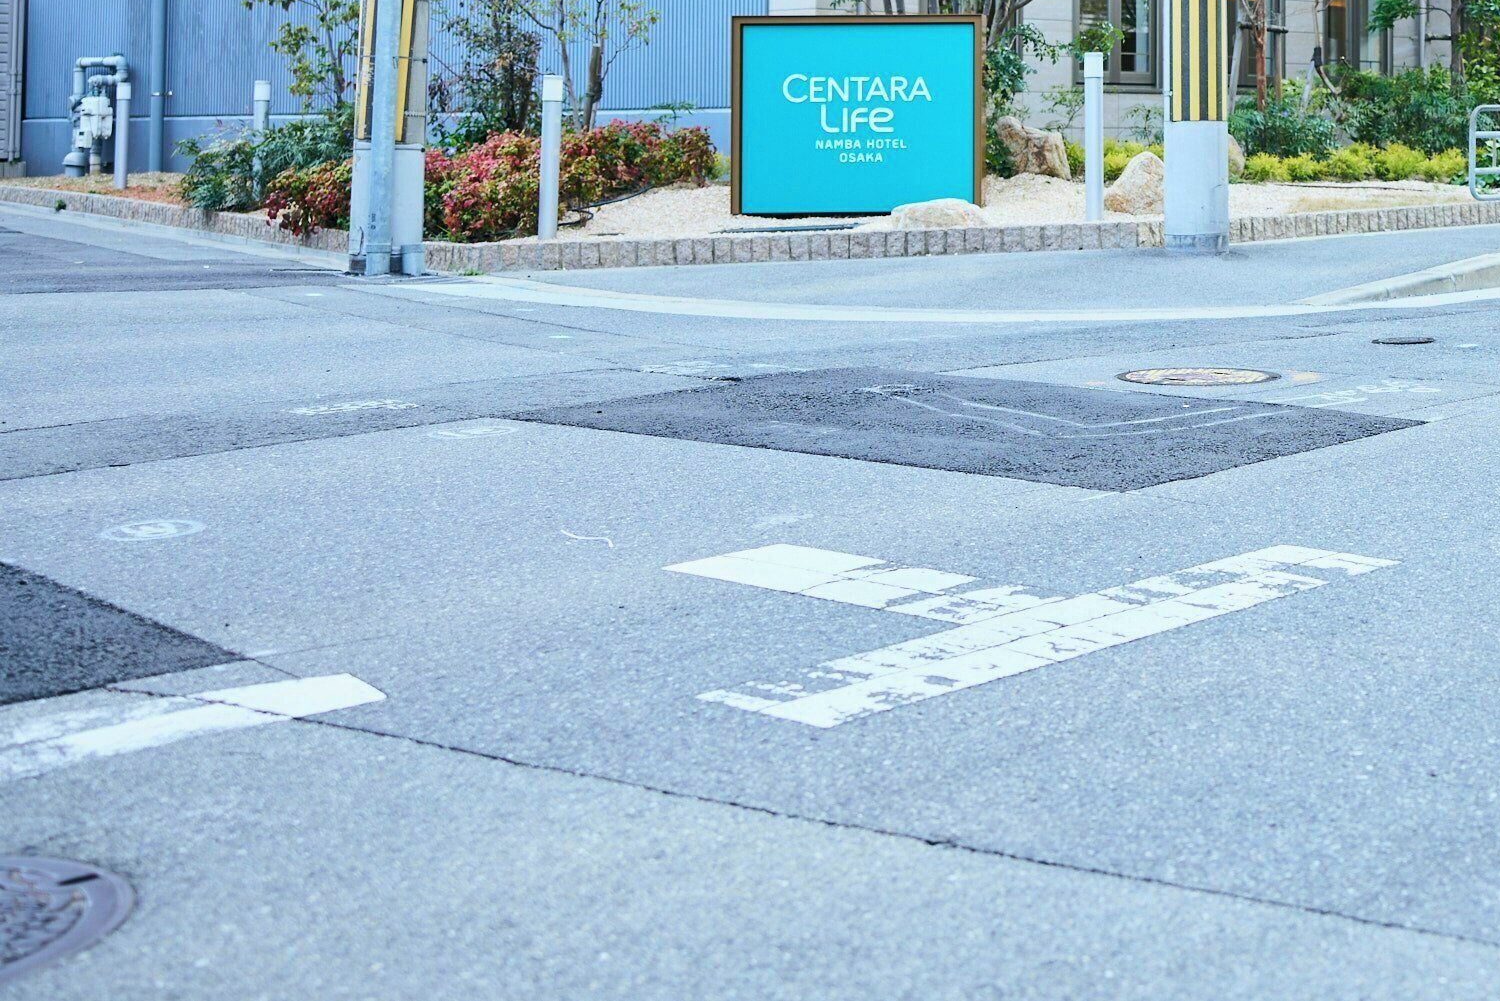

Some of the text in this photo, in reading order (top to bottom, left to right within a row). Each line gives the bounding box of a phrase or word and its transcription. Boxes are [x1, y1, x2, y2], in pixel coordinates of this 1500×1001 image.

[782, 73, 932, 103] CENTARA
[815, 139, 907, 150] NAMBA HOTEL
[839, 152, 884, 163] OSAKA
